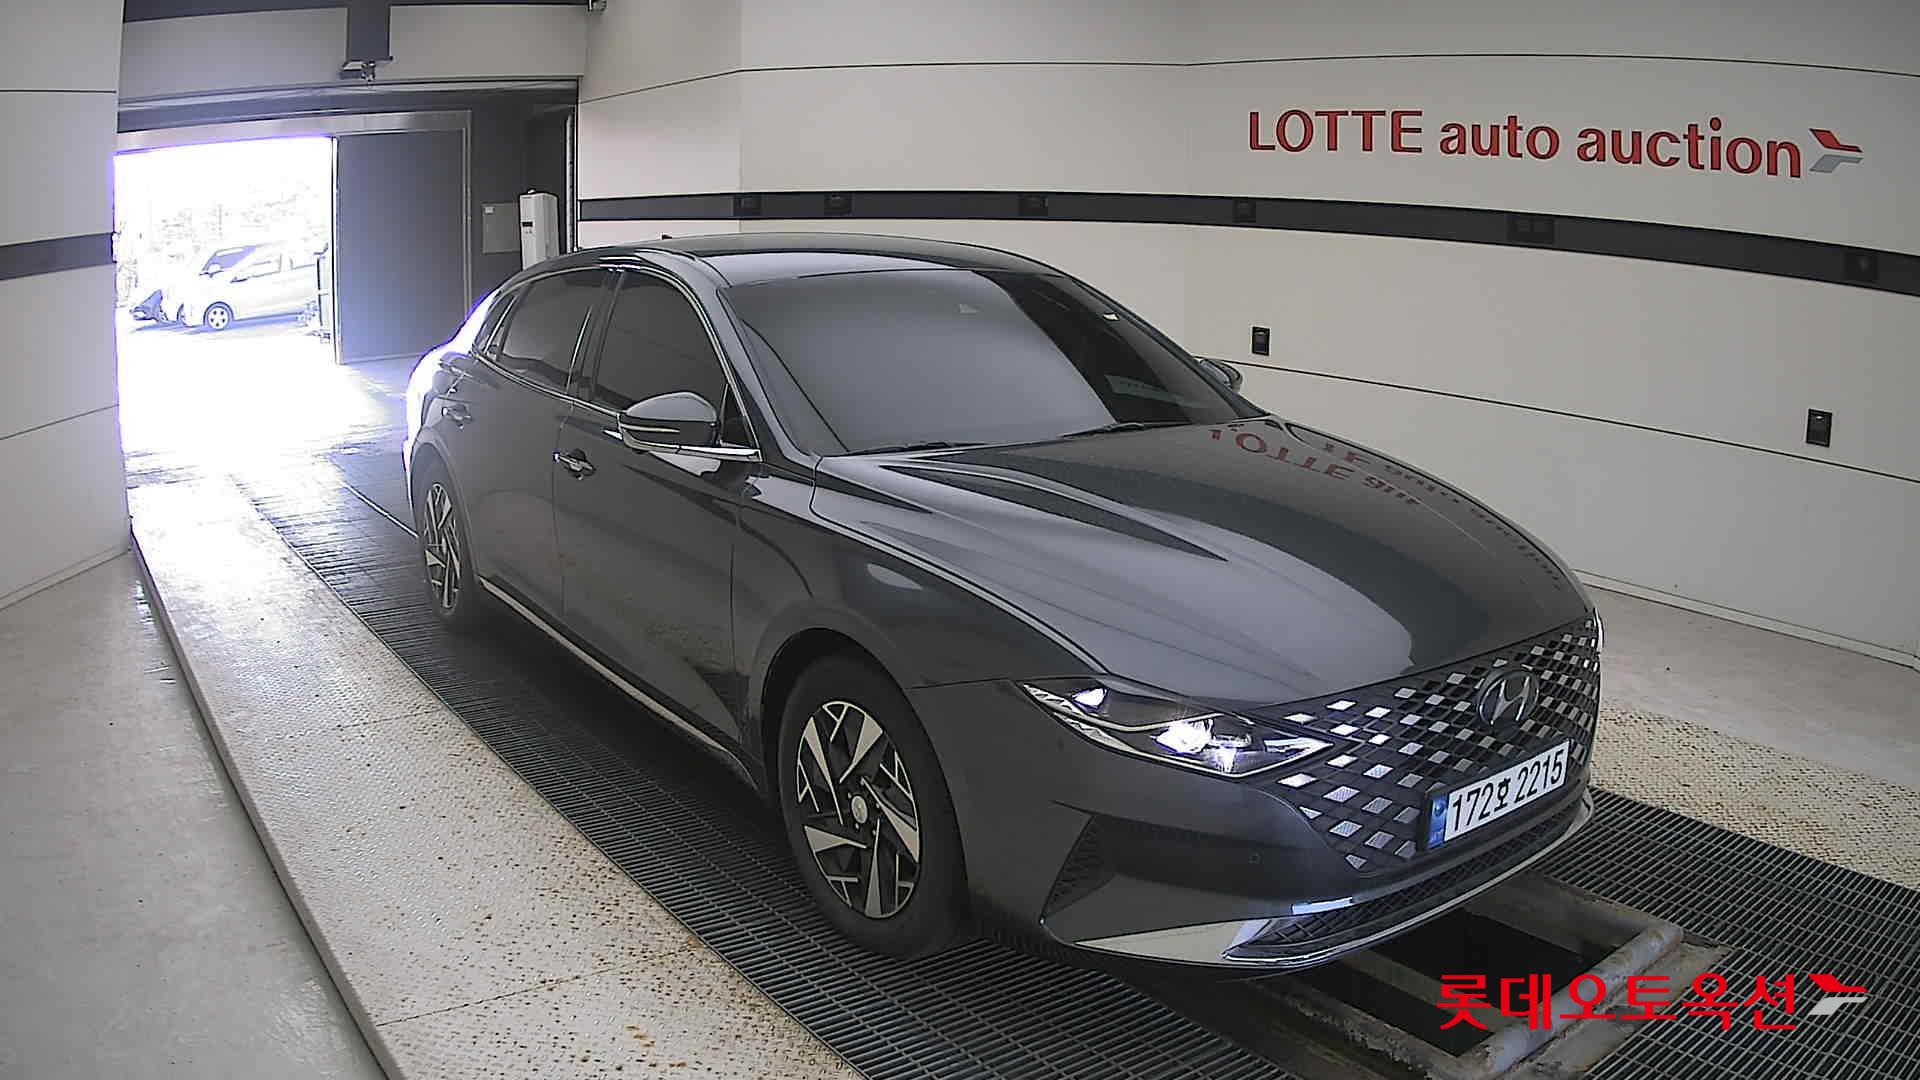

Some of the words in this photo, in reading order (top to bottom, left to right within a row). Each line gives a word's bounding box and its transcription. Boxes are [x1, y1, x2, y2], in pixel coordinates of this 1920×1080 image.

[1249, 110, 1423, 153] LOTTE
[1439, 115, 1560, 159] auto
[1576, 117, 1802, 178] auction
[1453, 777, 1511, 831] 172호
[1515, 749, 1564, 803] 2215
